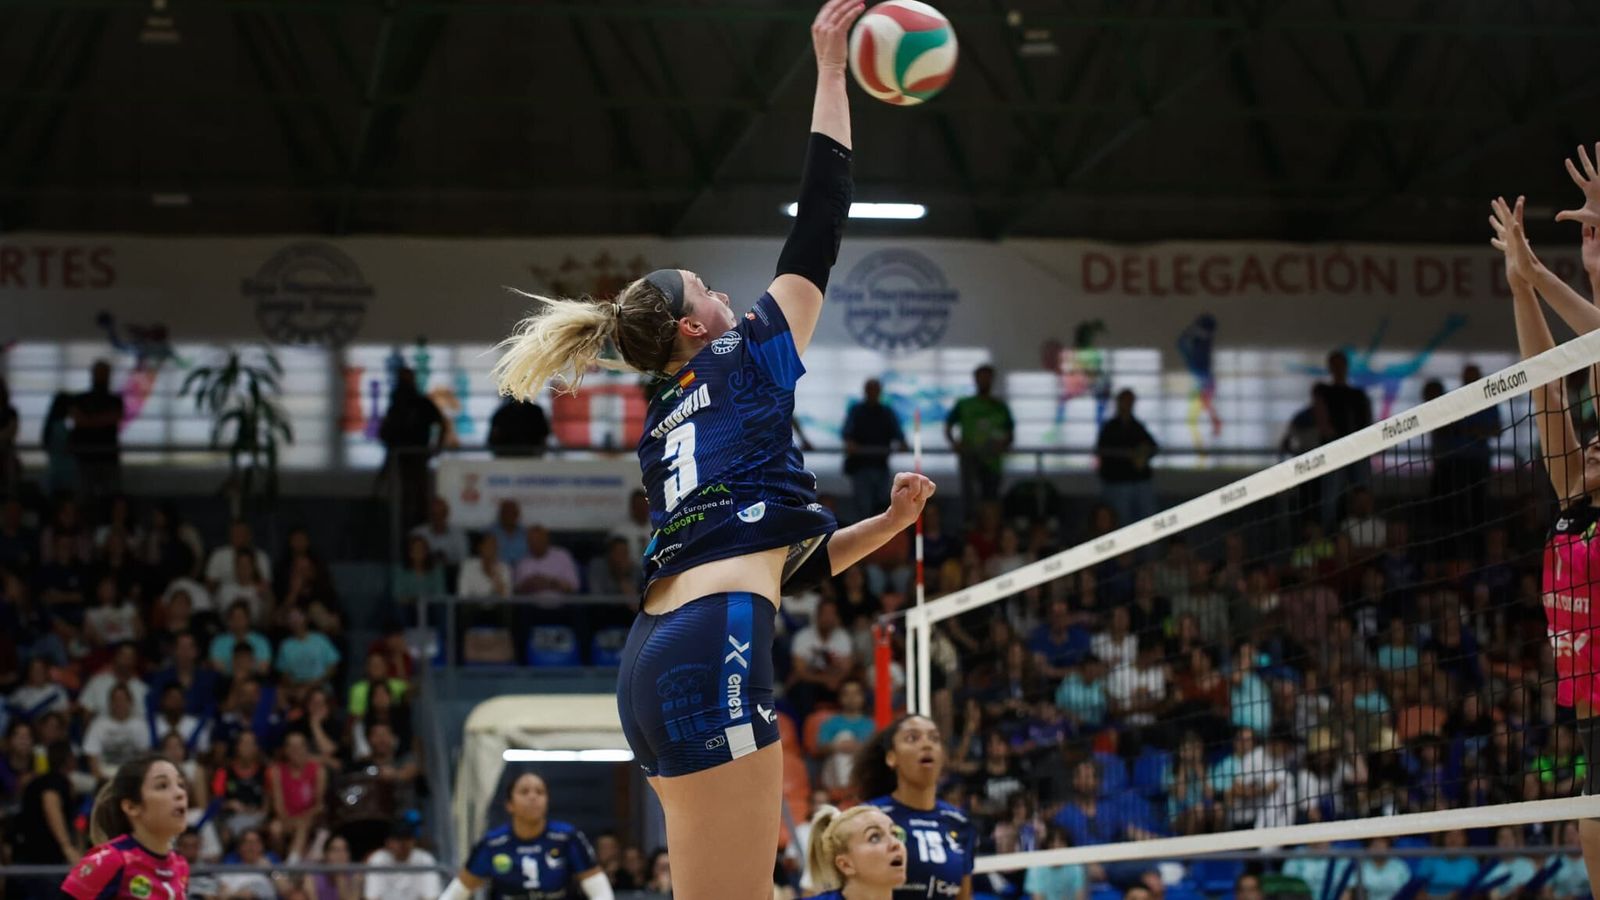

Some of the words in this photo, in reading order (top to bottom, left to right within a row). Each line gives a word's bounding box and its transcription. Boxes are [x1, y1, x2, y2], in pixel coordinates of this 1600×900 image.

[1081, 246, 1397, 298] DELEGACIÓN
[1415, 255, 1473, 298] DE
[1482, 369, 1528, 400] rfevb.com
[1381, 414, 1420, 441] rfevb.com
[661, 422, 698, 513] 3
[683, 500, 718, 514] Europea
[719, 497, 735, 506] del
[663, 512, 706, 535] DEPORTE
[912, 829, 947, 864] 15
